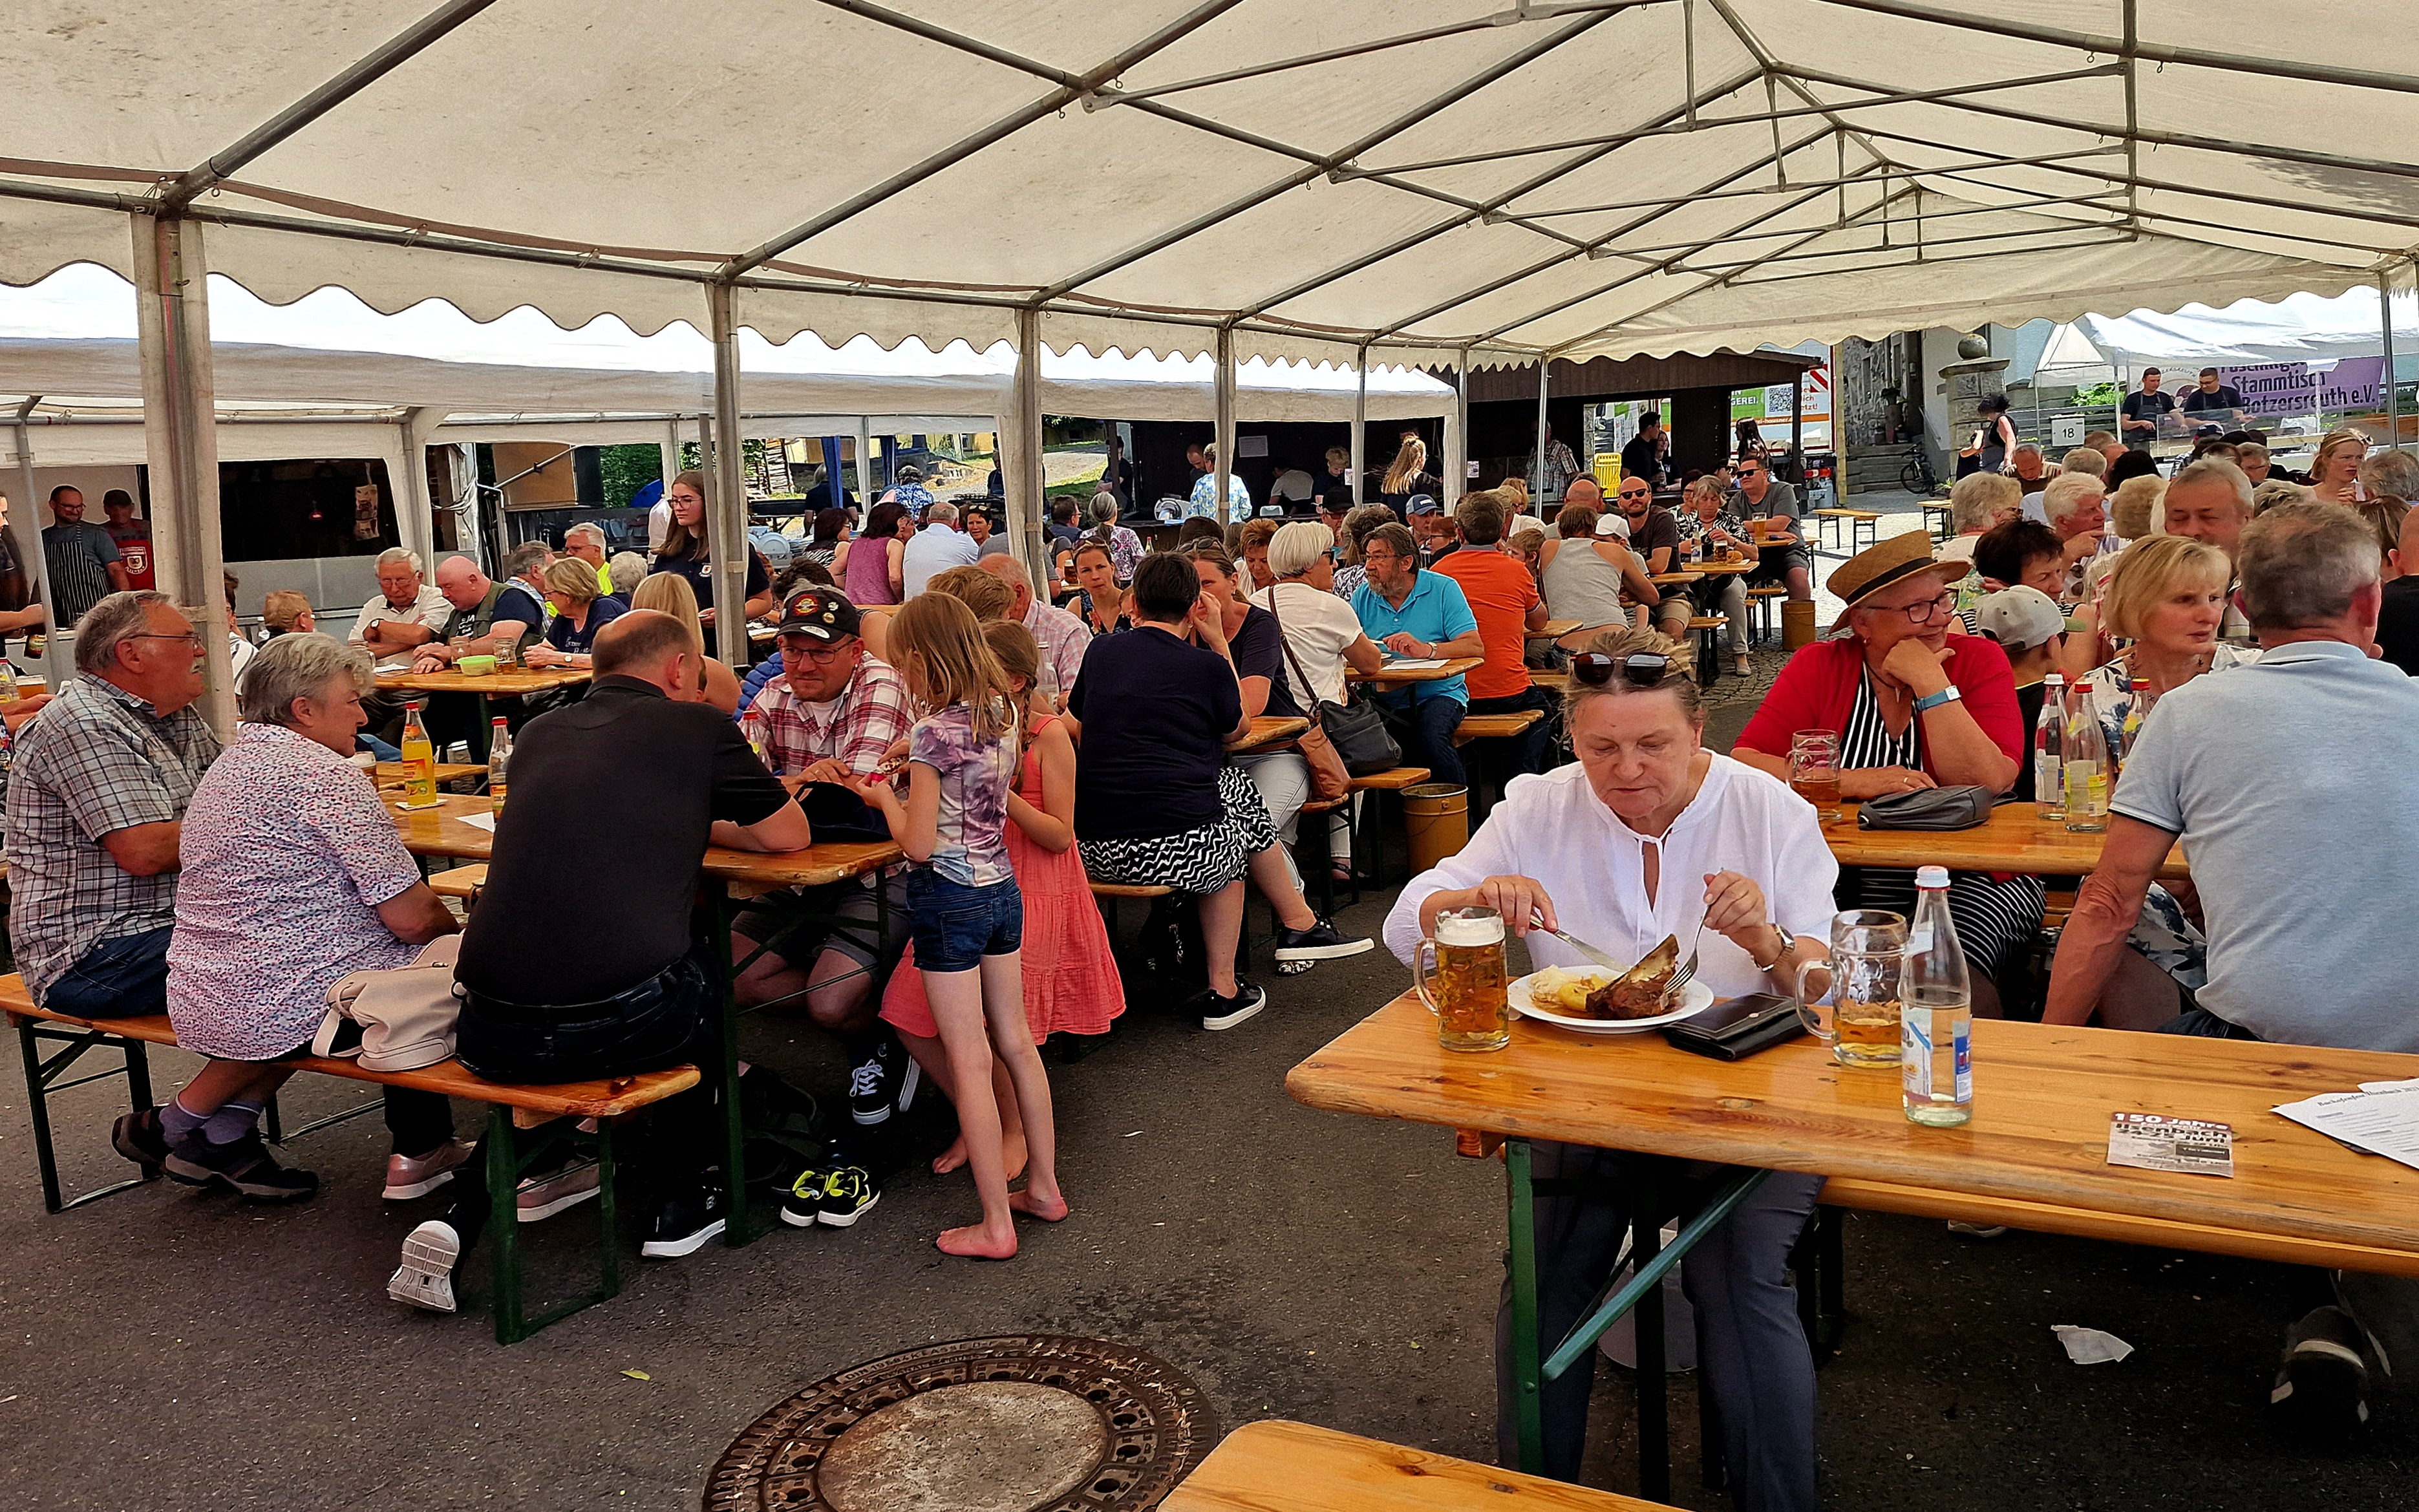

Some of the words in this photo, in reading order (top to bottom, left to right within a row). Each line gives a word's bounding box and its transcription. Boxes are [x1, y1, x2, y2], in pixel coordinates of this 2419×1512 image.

[2351, 384, 2376, 404] e.V.
[1731, 396, 1759, 405] GEREI.
[2062, 427, 2074, 438] 18
[2115, 1113, 2162, 1123] 150
[2166, 1118, 2228, 1130] Jahre
[2179, 1135, 2225, 1144] Juni
